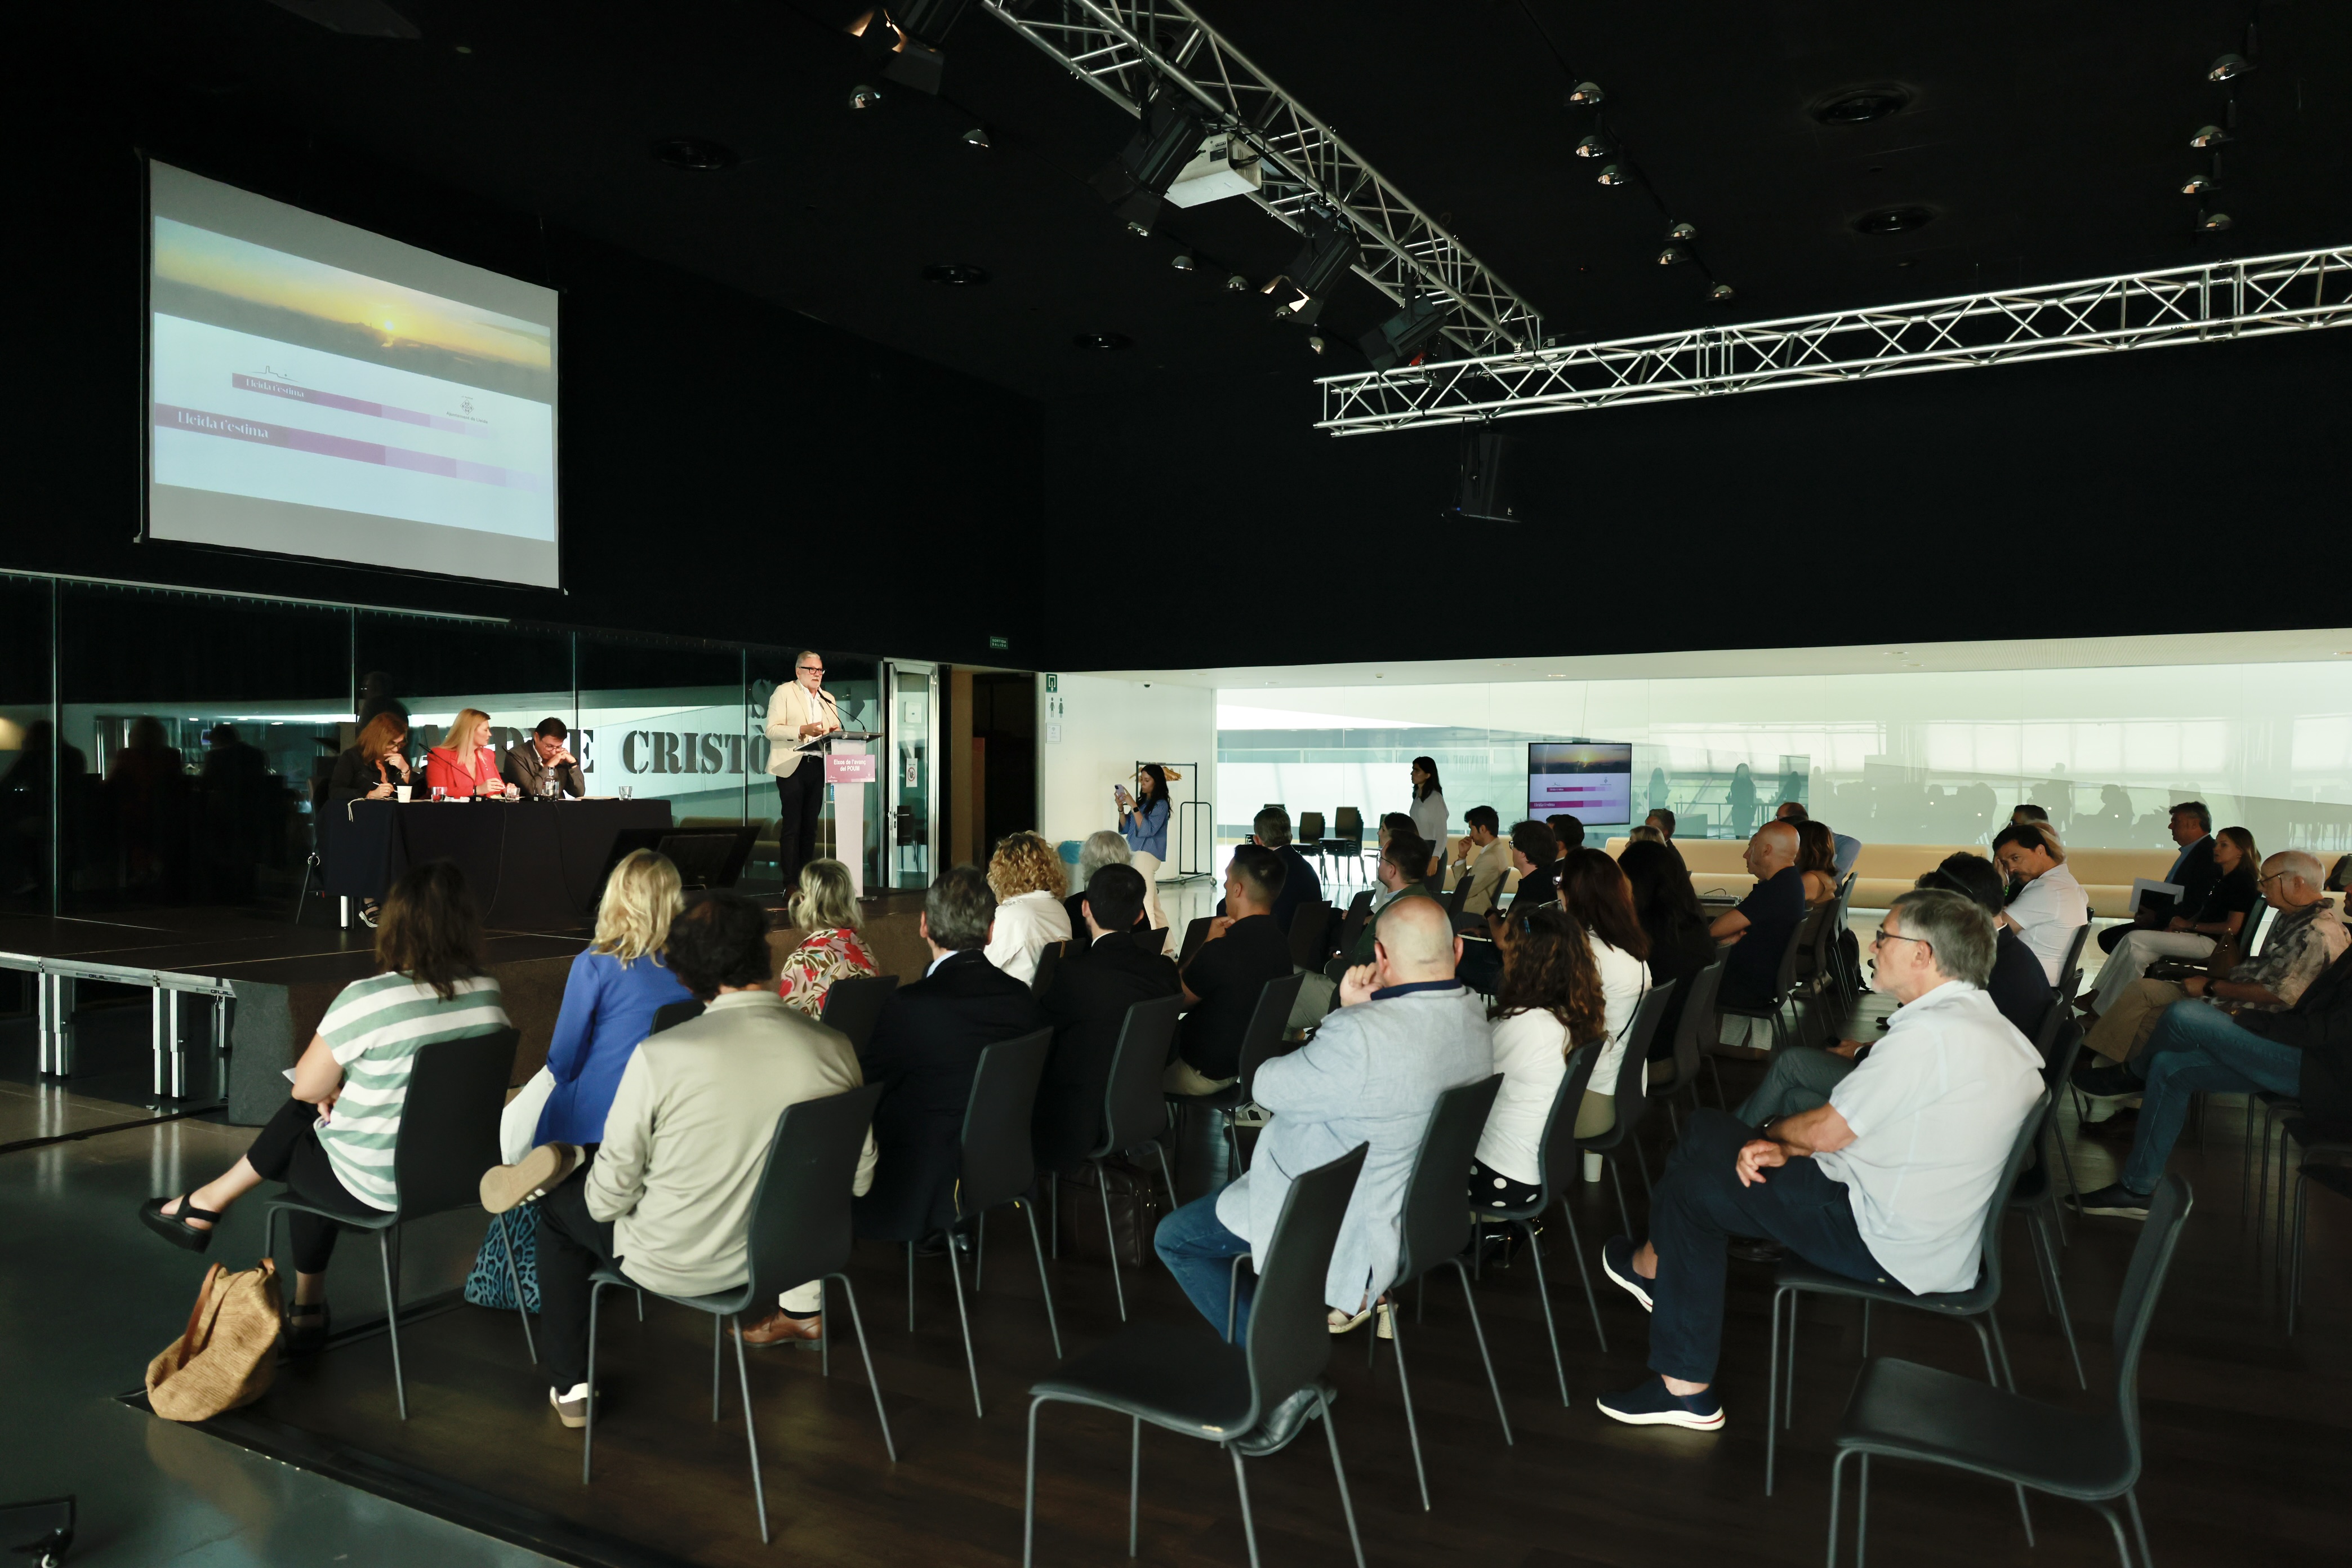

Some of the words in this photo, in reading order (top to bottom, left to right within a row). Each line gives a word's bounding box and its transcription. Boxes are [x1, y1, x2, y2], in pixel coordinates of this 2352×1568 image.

[246, 378, 271, 391] Lleida
[178, 411, 217, 429] Lleida
[220, 420, 269, 438] t'estima
[446, 411, 470, 420] Ajuntament
[622, 724, 770, 774] CRISTÒ
